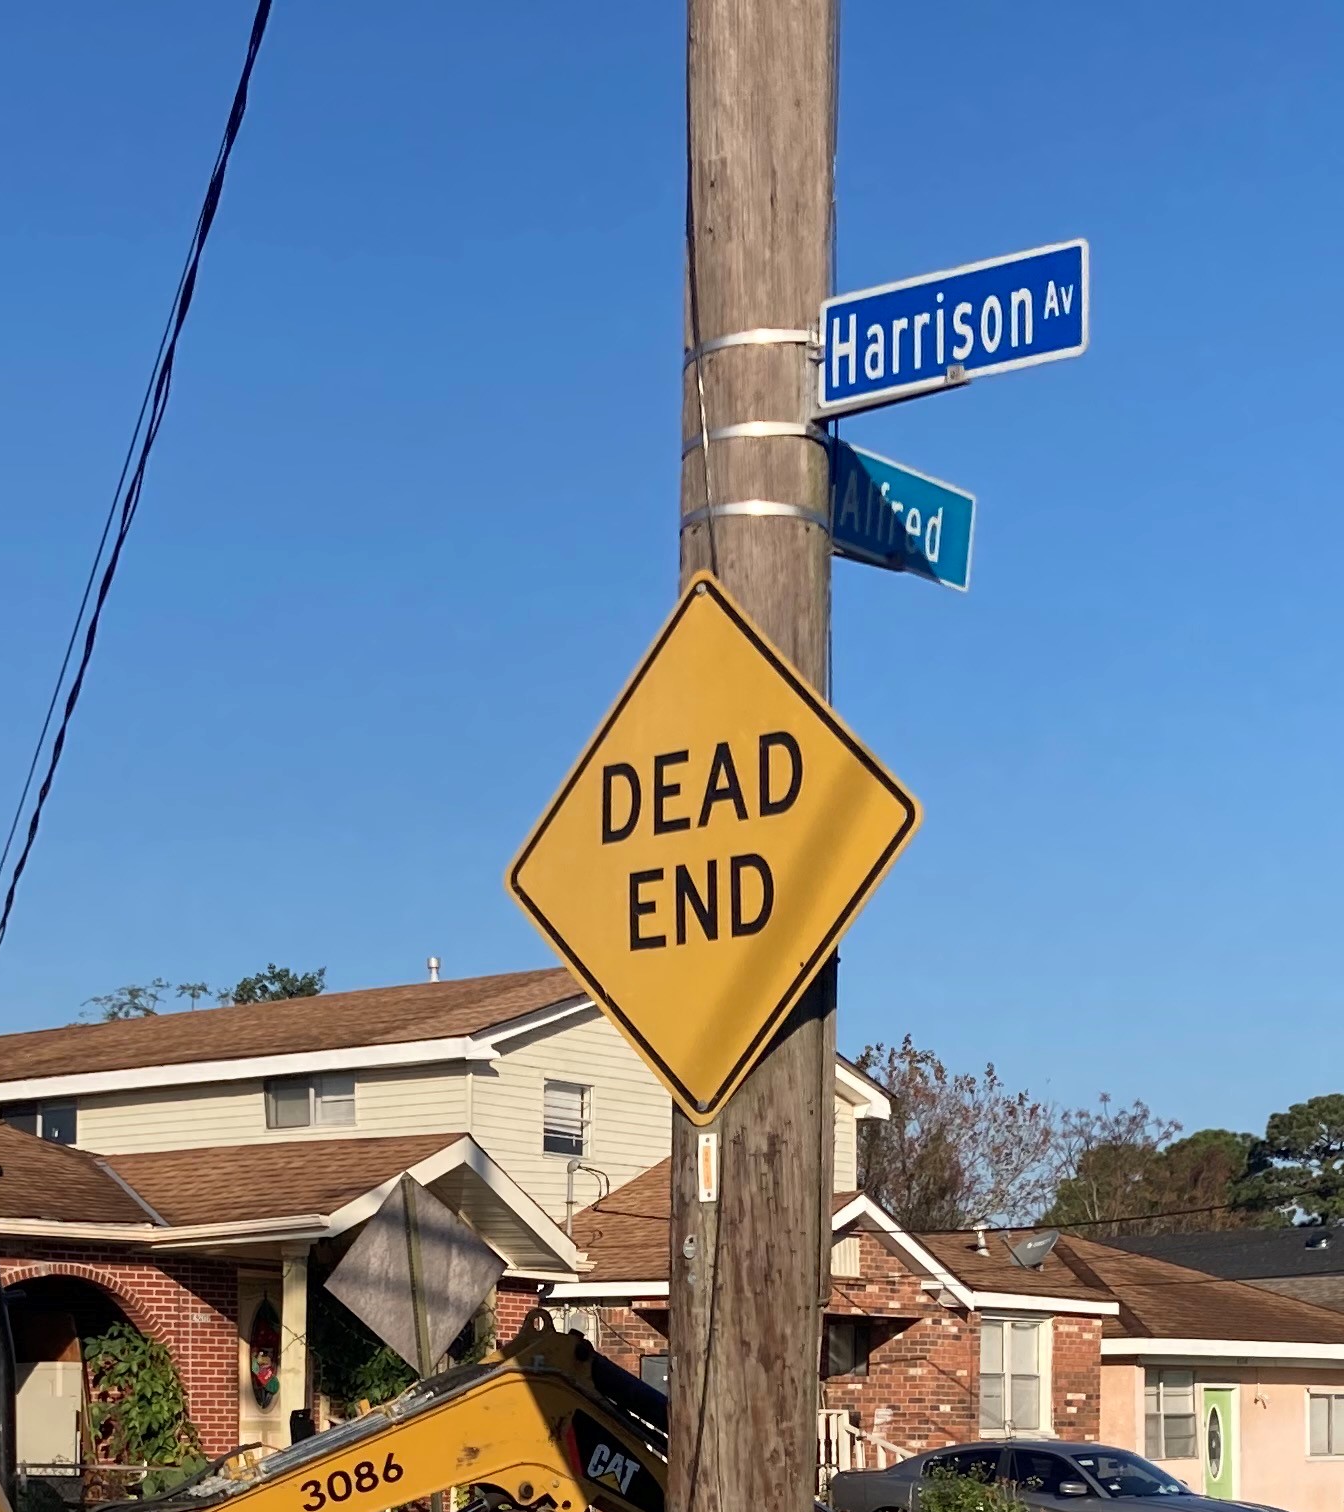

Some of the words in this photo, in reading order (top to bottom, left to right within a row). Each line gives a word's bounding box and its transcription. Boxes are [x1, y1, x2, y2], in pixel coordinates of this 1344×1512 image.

[832, 288, 1033, 388] Harrison
[1044, 280, 1074, 319] Av
[839, 469, 944, 563] Alfred
[601, 730, 804, 845] DEAD
[628, 852, 775, 952] END
[300, 1452, 404, 1512] 3086
[587, 1443, 640, 1496] CAT
